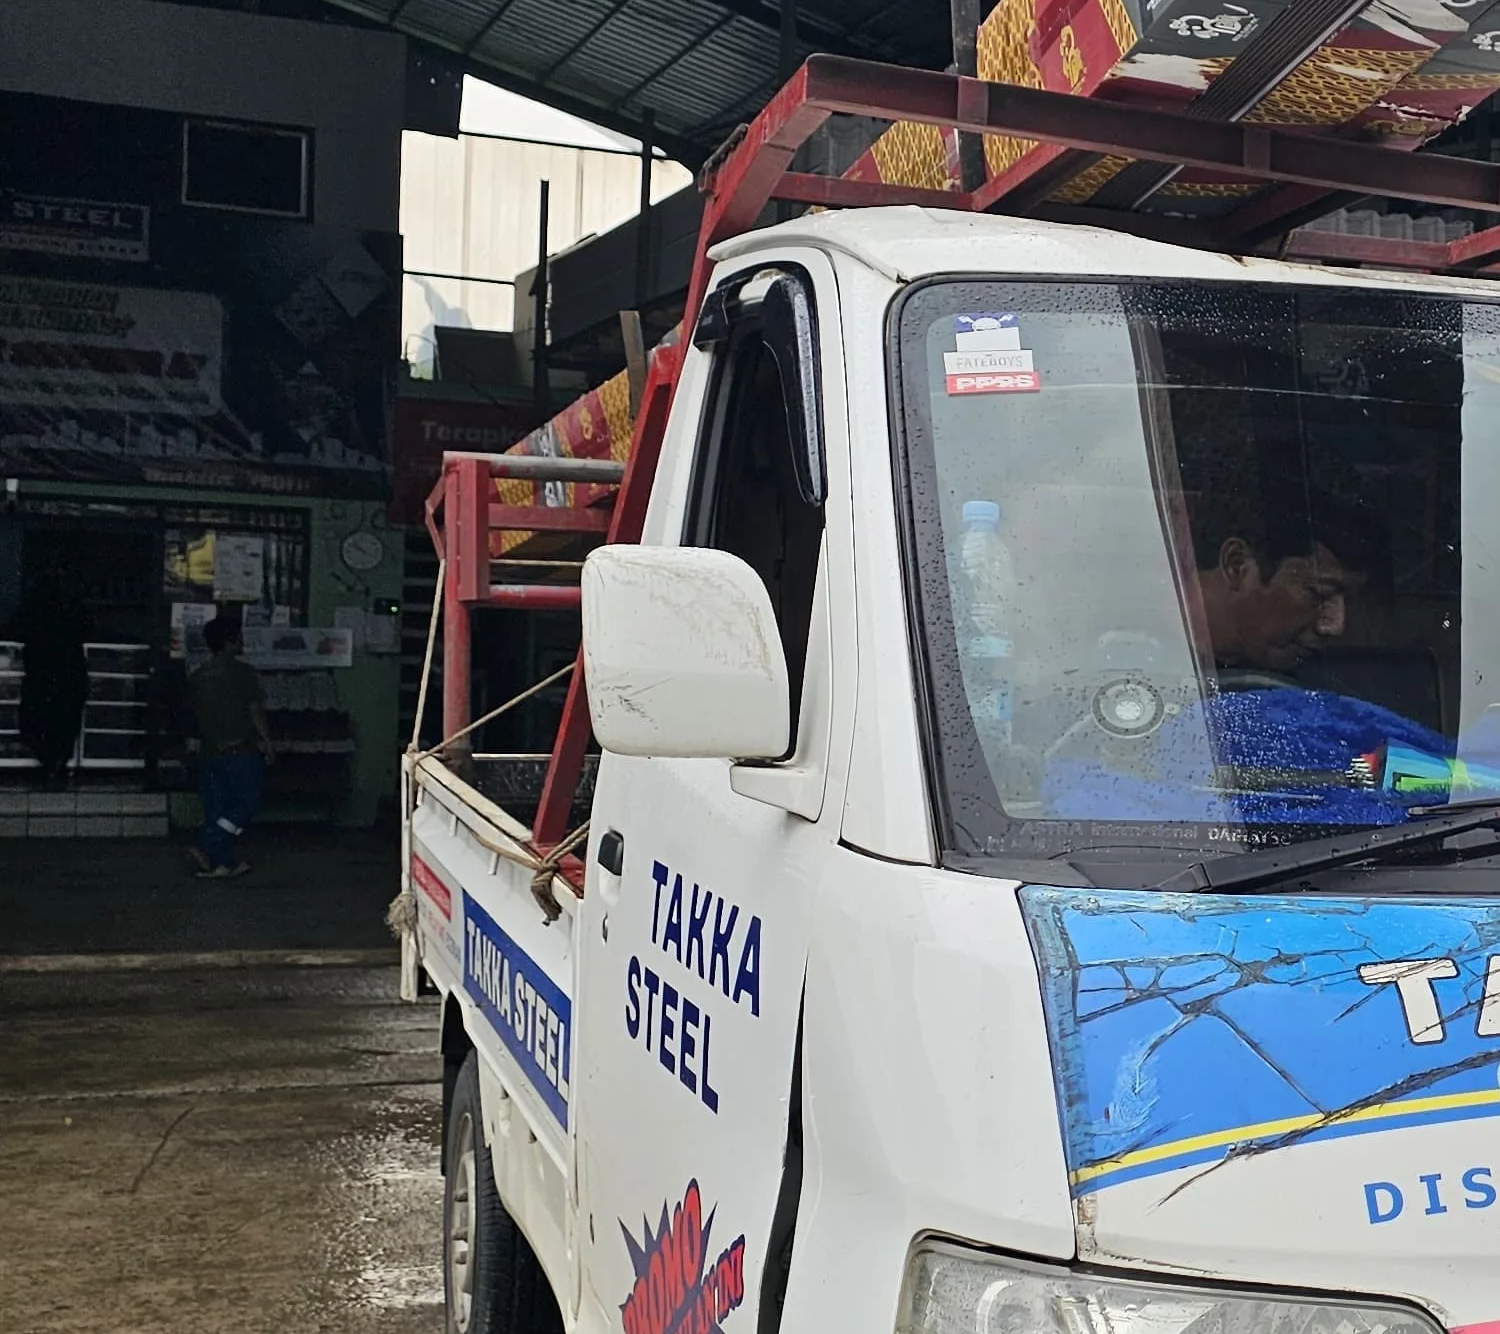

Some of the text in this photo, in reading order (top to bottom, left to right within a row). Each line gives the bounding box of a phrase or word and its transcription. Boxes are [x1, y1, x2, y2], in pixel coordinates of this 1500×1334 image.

[12, 201, 134, 229] STEEL
[467, 917, 569, 1101] TAKKA STEEL
[652, 859, 762, 1018] TAKKA
[626, 955, 719, 1115] STEEL
